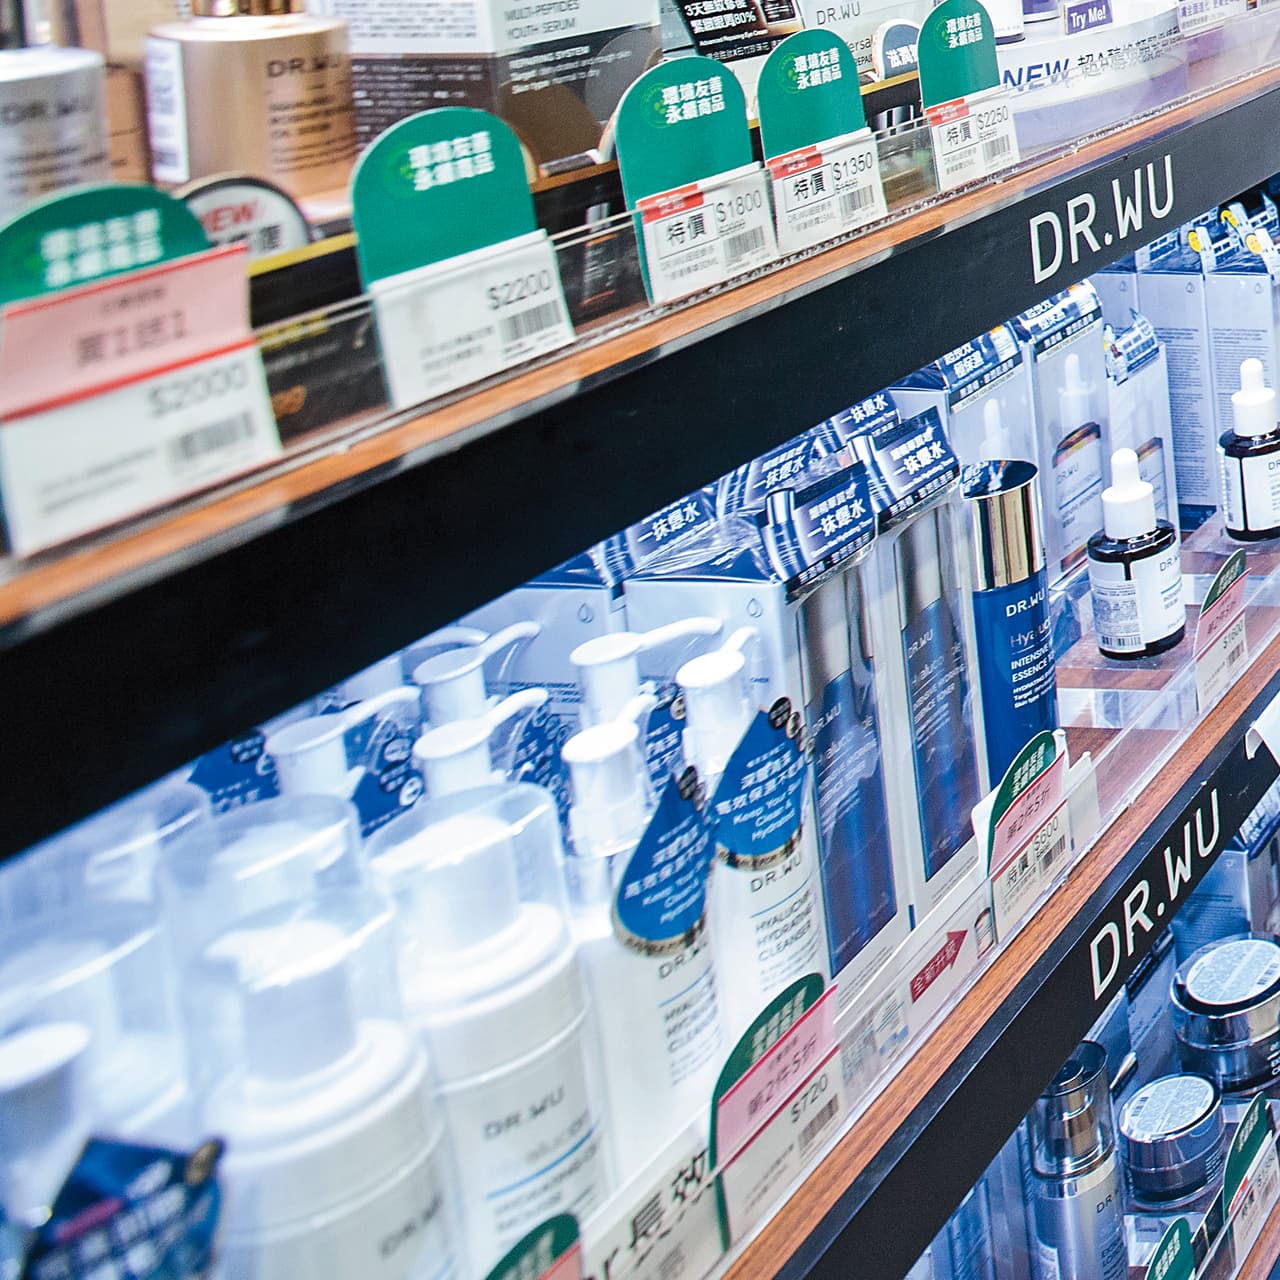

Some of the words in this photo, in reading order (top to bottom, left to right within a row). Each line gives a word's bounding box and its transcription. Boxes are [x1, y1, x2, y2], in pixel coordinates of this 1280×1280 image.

[541, 18, 576, 35] SERUM
[816, 1, 862, 25] DR.WU
[1070, 10, 1086, 29] Try
[1088, 6, 1107, 22] Me!
[793, 47, 840, 73] 環境友善
[849, 38, 871, 52] ersal
[661, 76, 723, 106] 環境友善
[1001, 57, 1071, 91] NEW
[946, 121, 973, 145] 特價
[976, 105, 1009, 130] $2250
[793, 171, 826, 201] 特價
[833, 151, 873, 181] $1350
[666, 213, 707, 246] 特價
[716, 189, 762, 223] $1800
[1029, 154, 1175, 285] DR.WU
[485, 269, 554, 312] $2200
[893, 440, 948, 476] 一抹爆水
[807, 498, 866, 538] 一抹爆水
[1005, 589, 1046, 618] DR.WU
[1010, 643, 1050, 670] INTENSIVE
[1012, 658, 1048, 683] ESSENCE
[1033, 815, 1060, 852] $600
[1088, 786, 1221, 1002] DR.WU
[790, 1073, 829, 1125] $720
